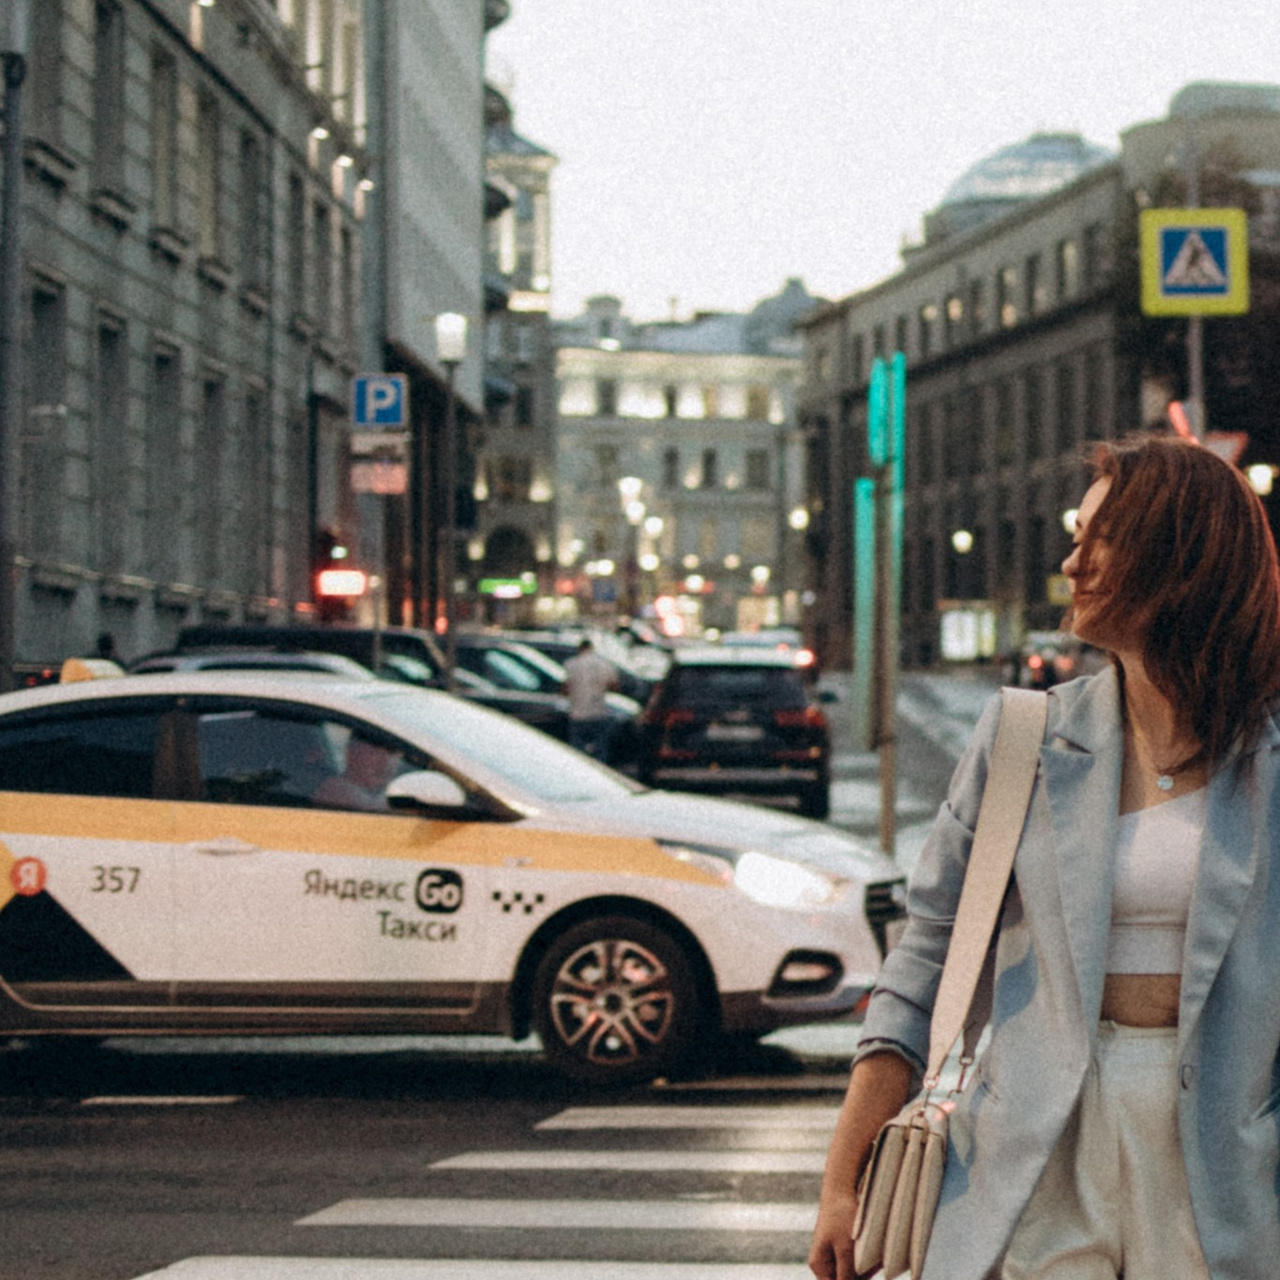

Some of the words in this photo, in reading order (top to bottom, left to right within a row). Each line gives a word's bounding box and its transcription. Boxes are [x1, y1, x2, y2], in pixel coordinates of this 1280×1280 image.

[366, 381, 396, 421] P
[19, 862, 38, 887] Я
[91, 865, 140, 893] 357
[304, 870, 407, 901] Яндекс
[418, 873, 461, 909] Go
[377, 910, 456, 941] Такси
